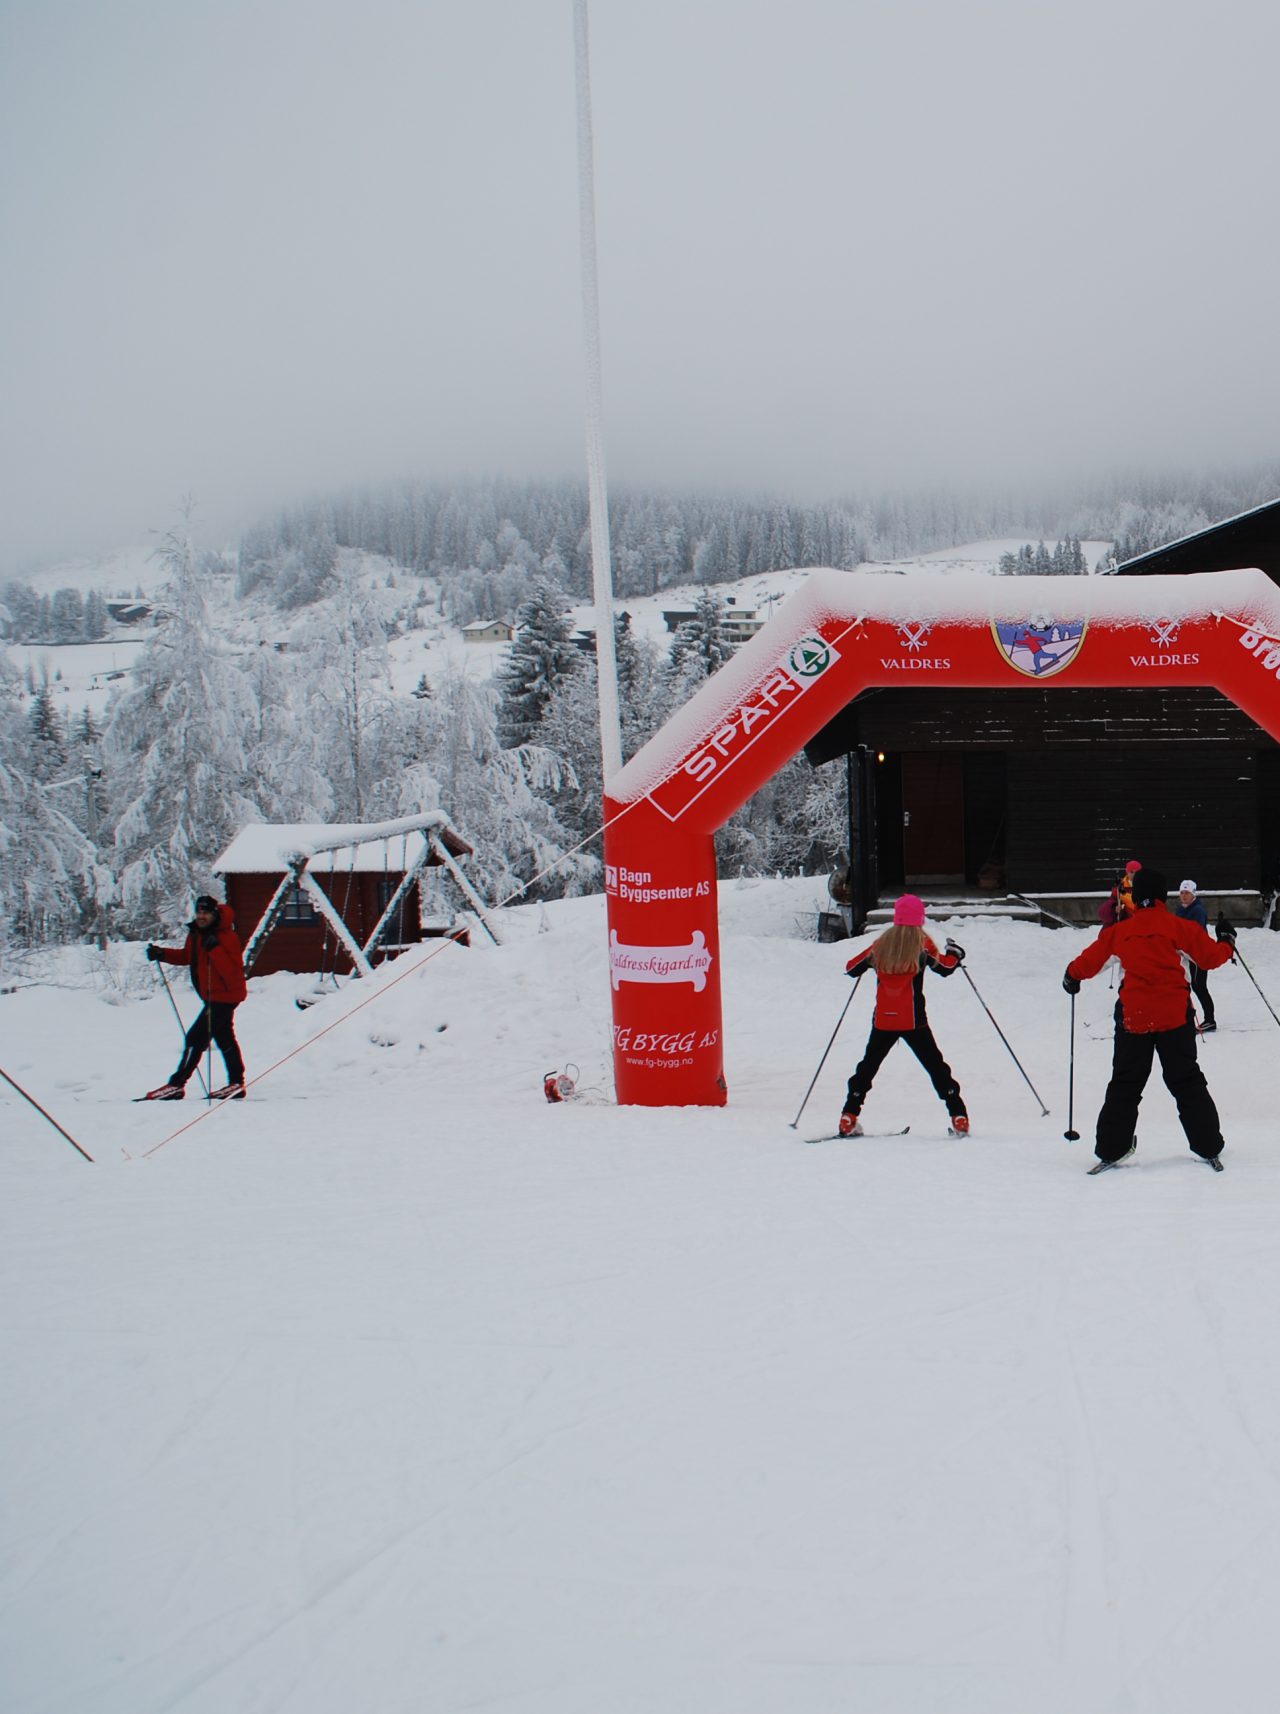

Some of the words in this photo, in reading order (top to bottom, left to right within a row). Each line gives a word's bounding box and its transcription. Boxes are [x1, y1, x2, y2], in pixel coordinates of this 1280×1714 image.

[880, 658, 951, 669] VALDRES
[1129, 653, 1200, 667] VALDRES
[684, 673, 795, 782] SPAR
[619, 866, 651, 886] Bagn
[619, 883, 693, 903] Byggsenter
[695, 881, 710, 896] AS
[632, 1031, 697, 1054] BYGG
[698, 1029, 719, 1048] AS
[625, 1057, 694, 1068] www.fg-bygg.no
